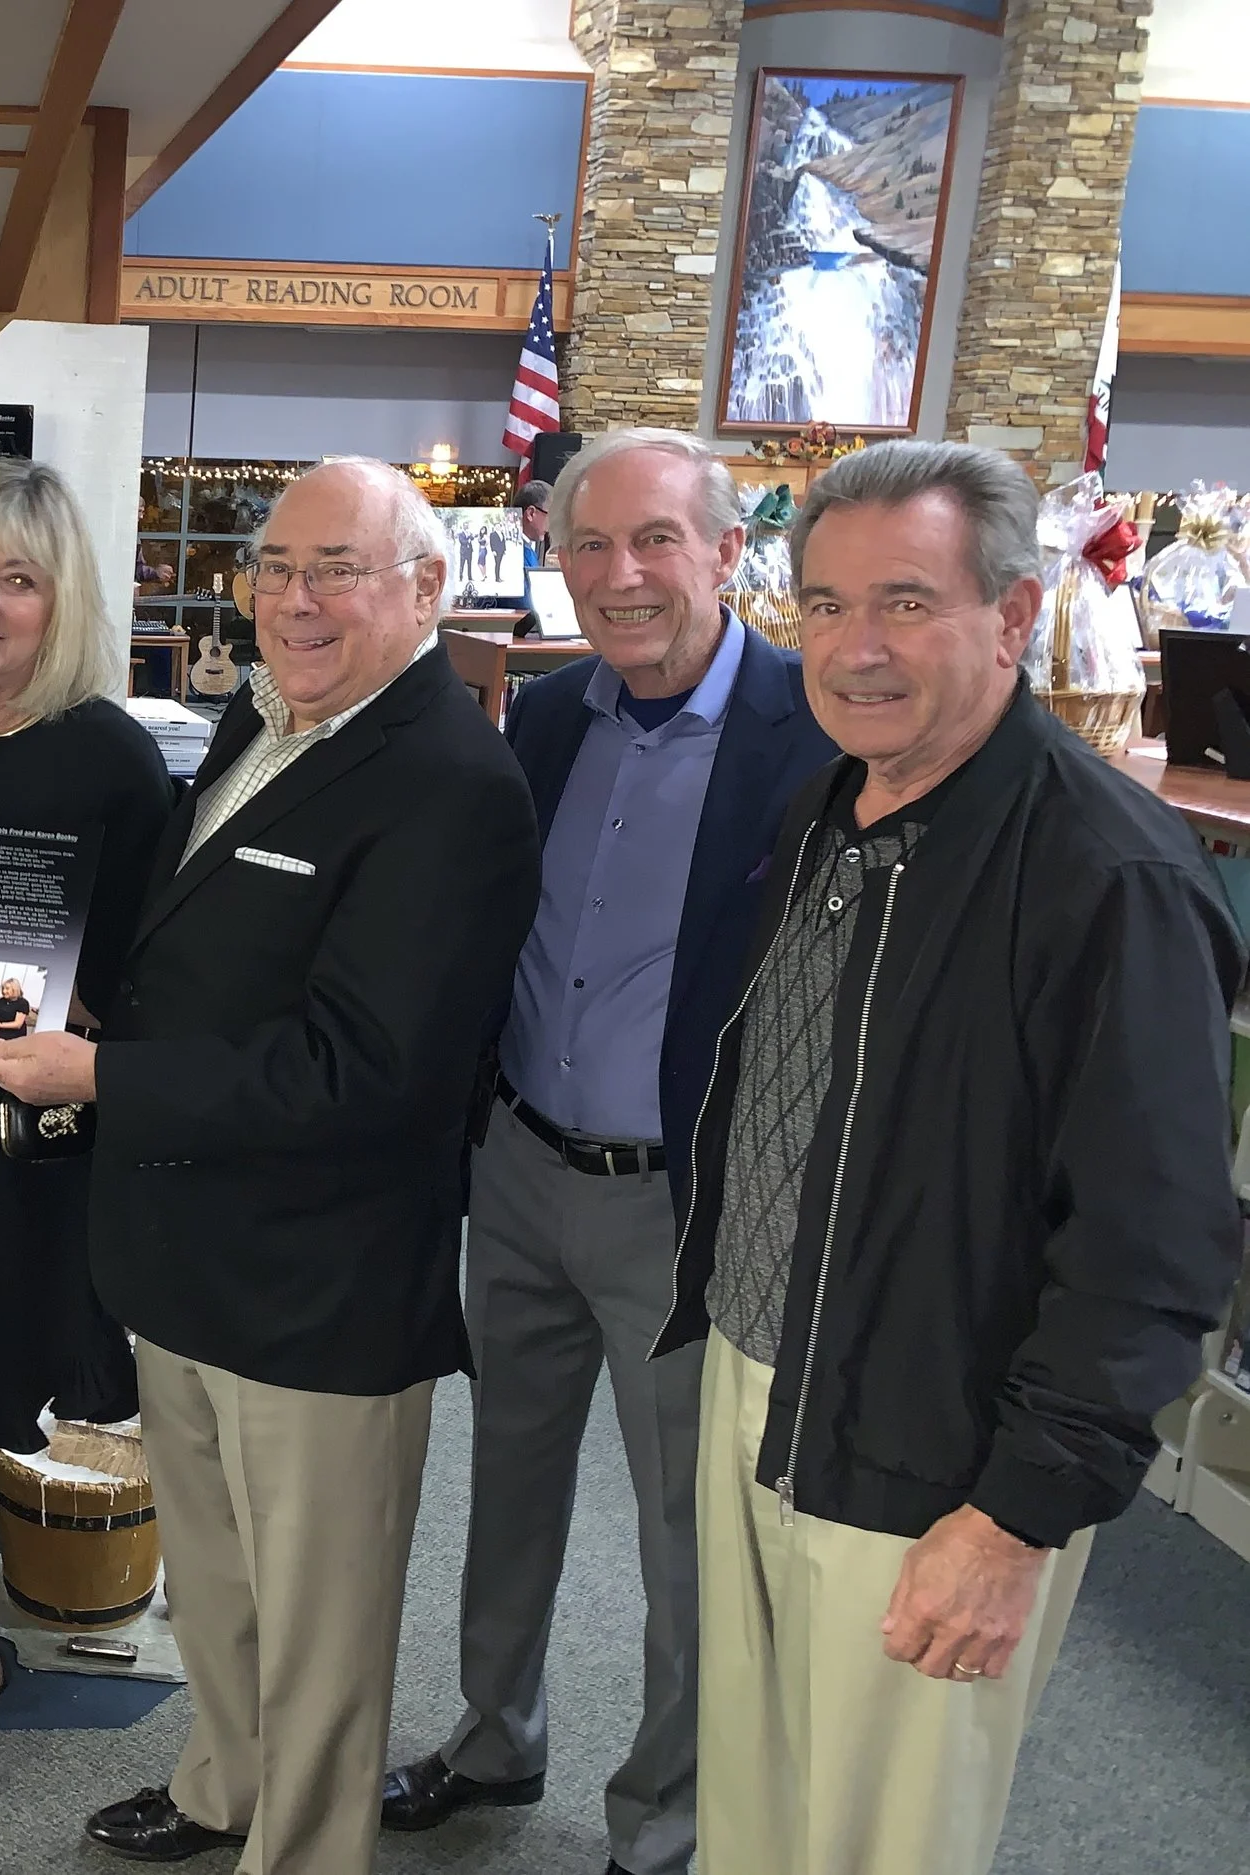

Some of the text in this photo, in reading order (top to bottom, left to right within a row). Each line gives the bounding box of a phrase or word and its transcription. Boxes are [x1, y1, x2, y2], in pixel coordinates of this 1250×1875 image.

[136, 276, 480, 309] ADULT READING ROOM
[9, 828, 24, 836] Fred
[37, 831, 55, 839] Karen
[56, 832, 78, 842] Bookey
